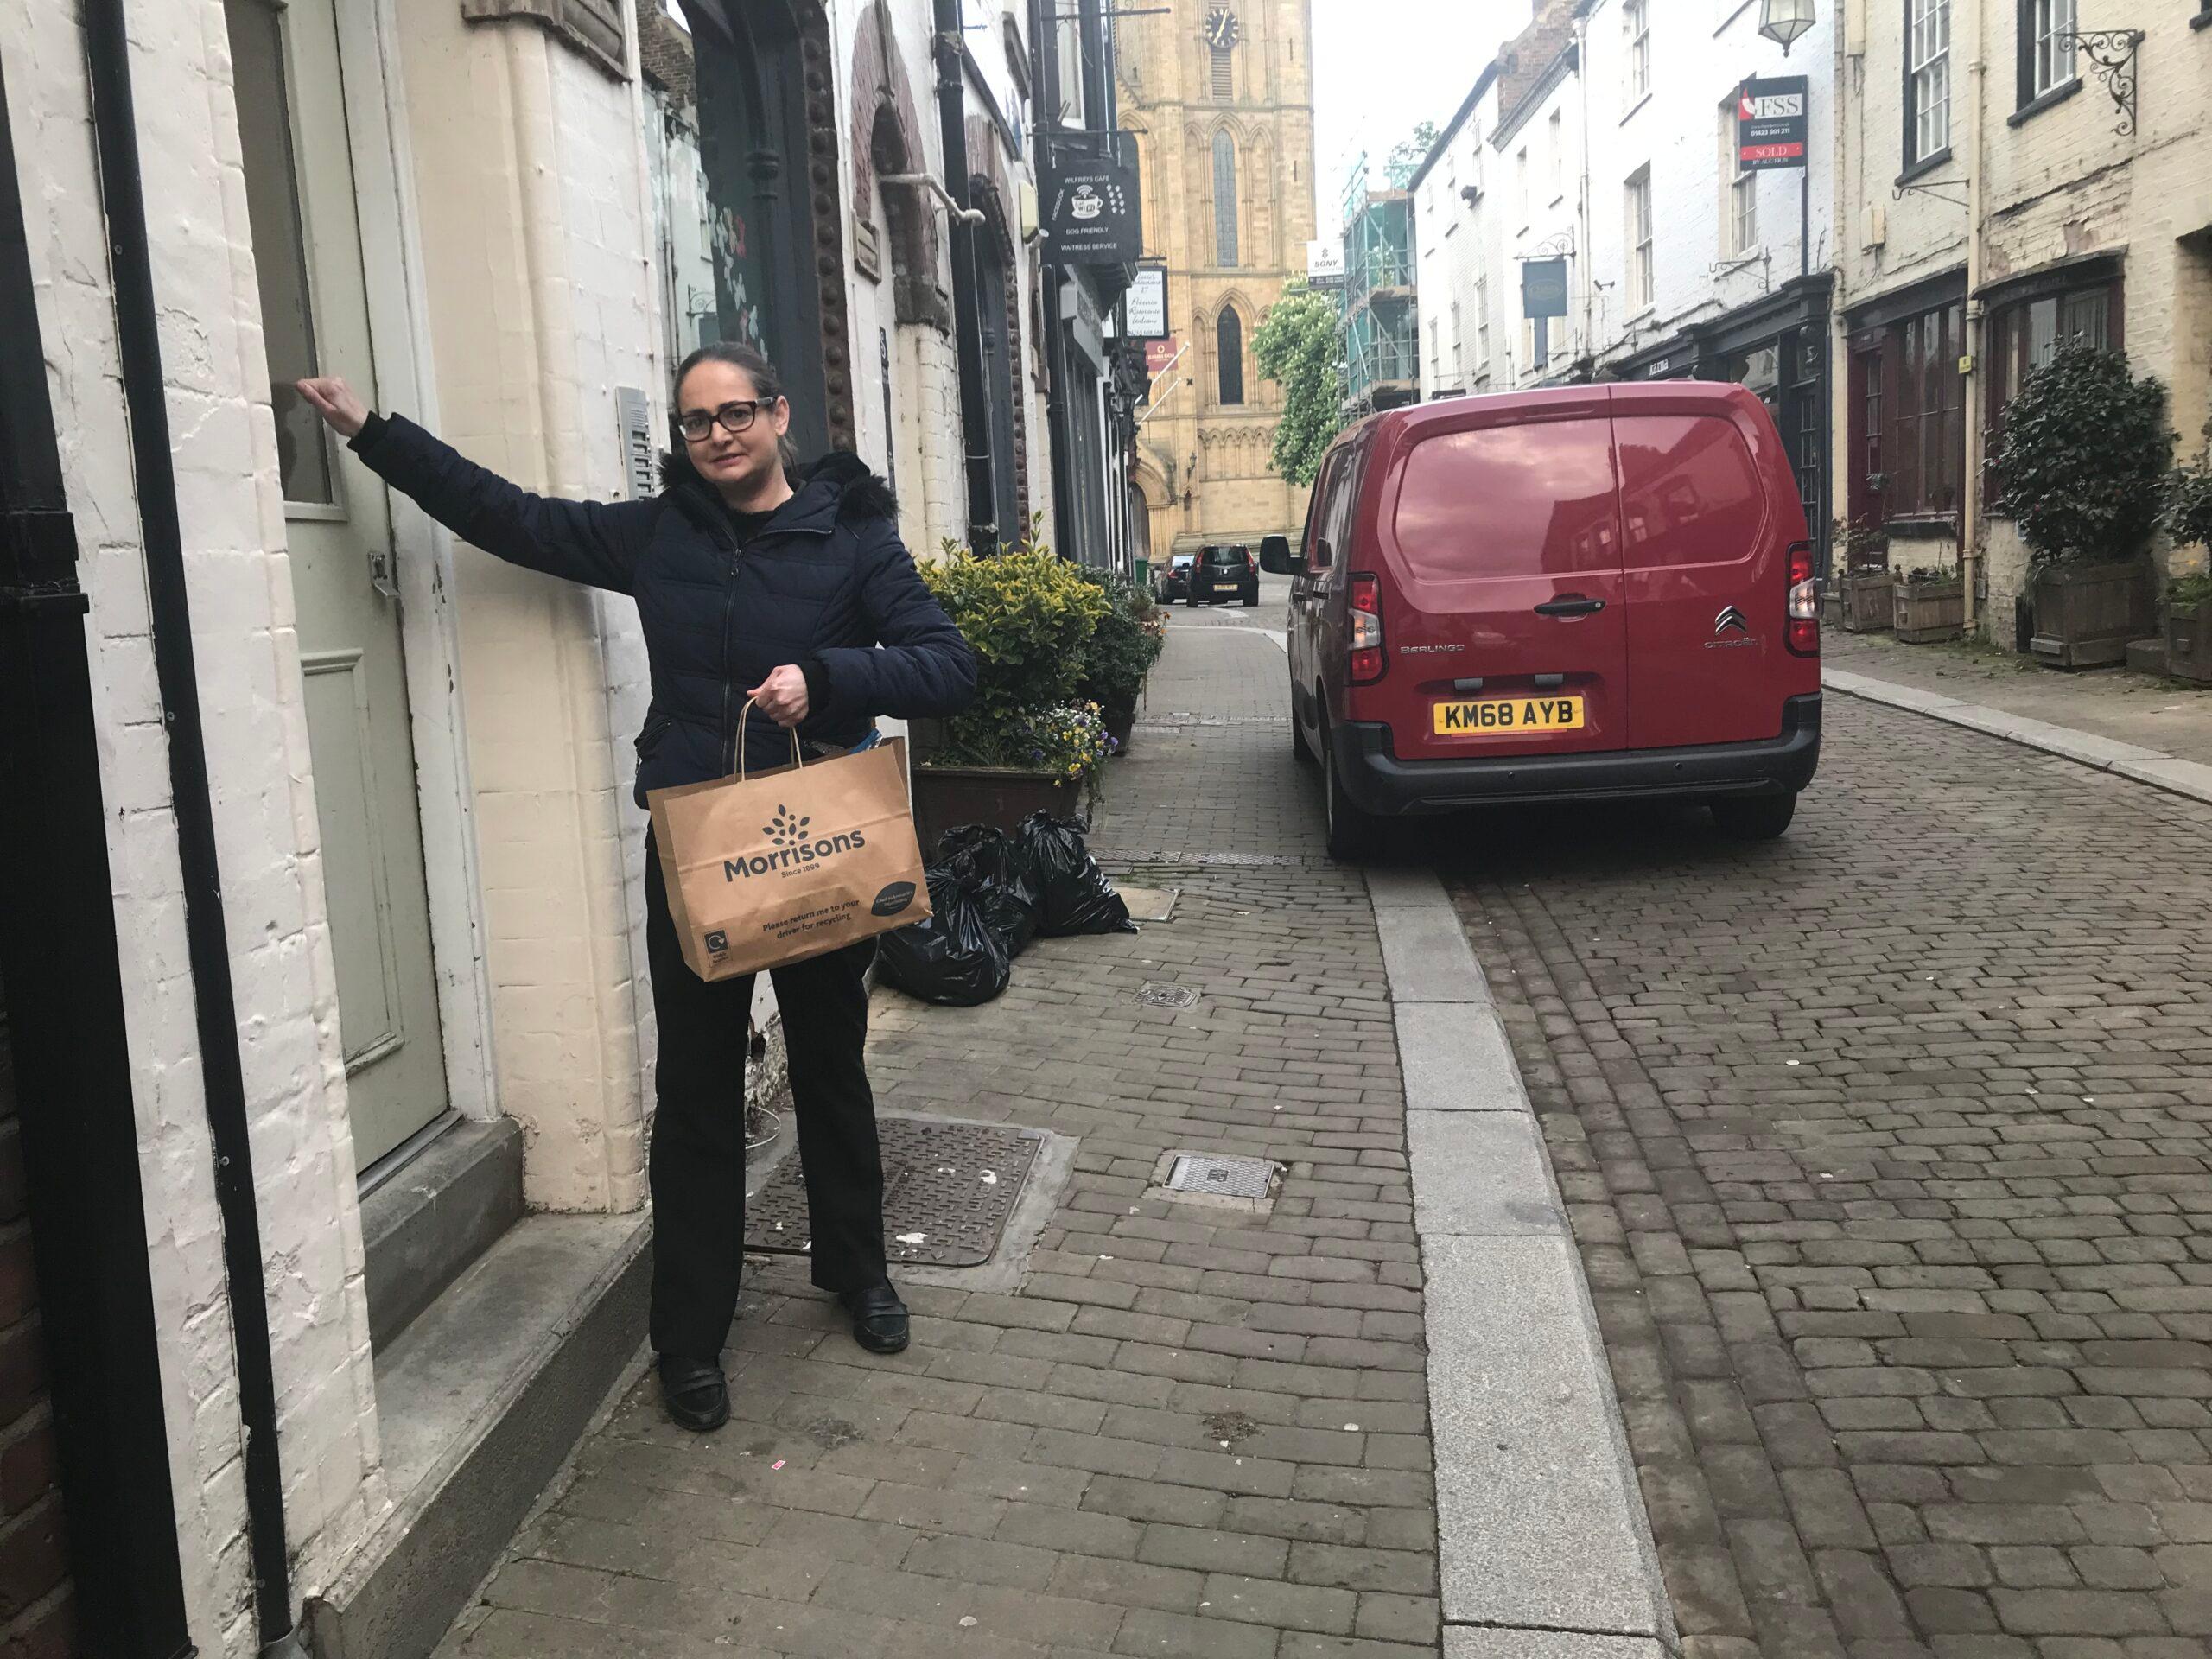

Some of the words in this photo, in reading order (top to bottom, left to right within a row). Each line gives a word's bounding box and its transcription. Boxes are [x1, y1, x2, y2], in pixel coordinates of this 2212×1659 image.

[1761, 96, 1798, 117] FSS
[1755, 145, 1787, 157] SOLD
[1400, 643, 1465, 654] BERLINGO
[1445, 702, 1515, 729] KM68
[1522, 700, 1573, 725] AYB
[723, 830, 866, 882] Morrisons
[780, 867, 802, 878] Since
[803, 862, 820, 874] 1899
[762, 916, 789, 932] Please
[790, 911, 815, 924] return
[817, 908, 829, 917] me
[830, 904, 840, 914] to
[842, 899, 860, 913] your
[777, 926, 800, 939] driver
[802, 921, 814, 933] for
[816, 913, 852, 929] recycling
